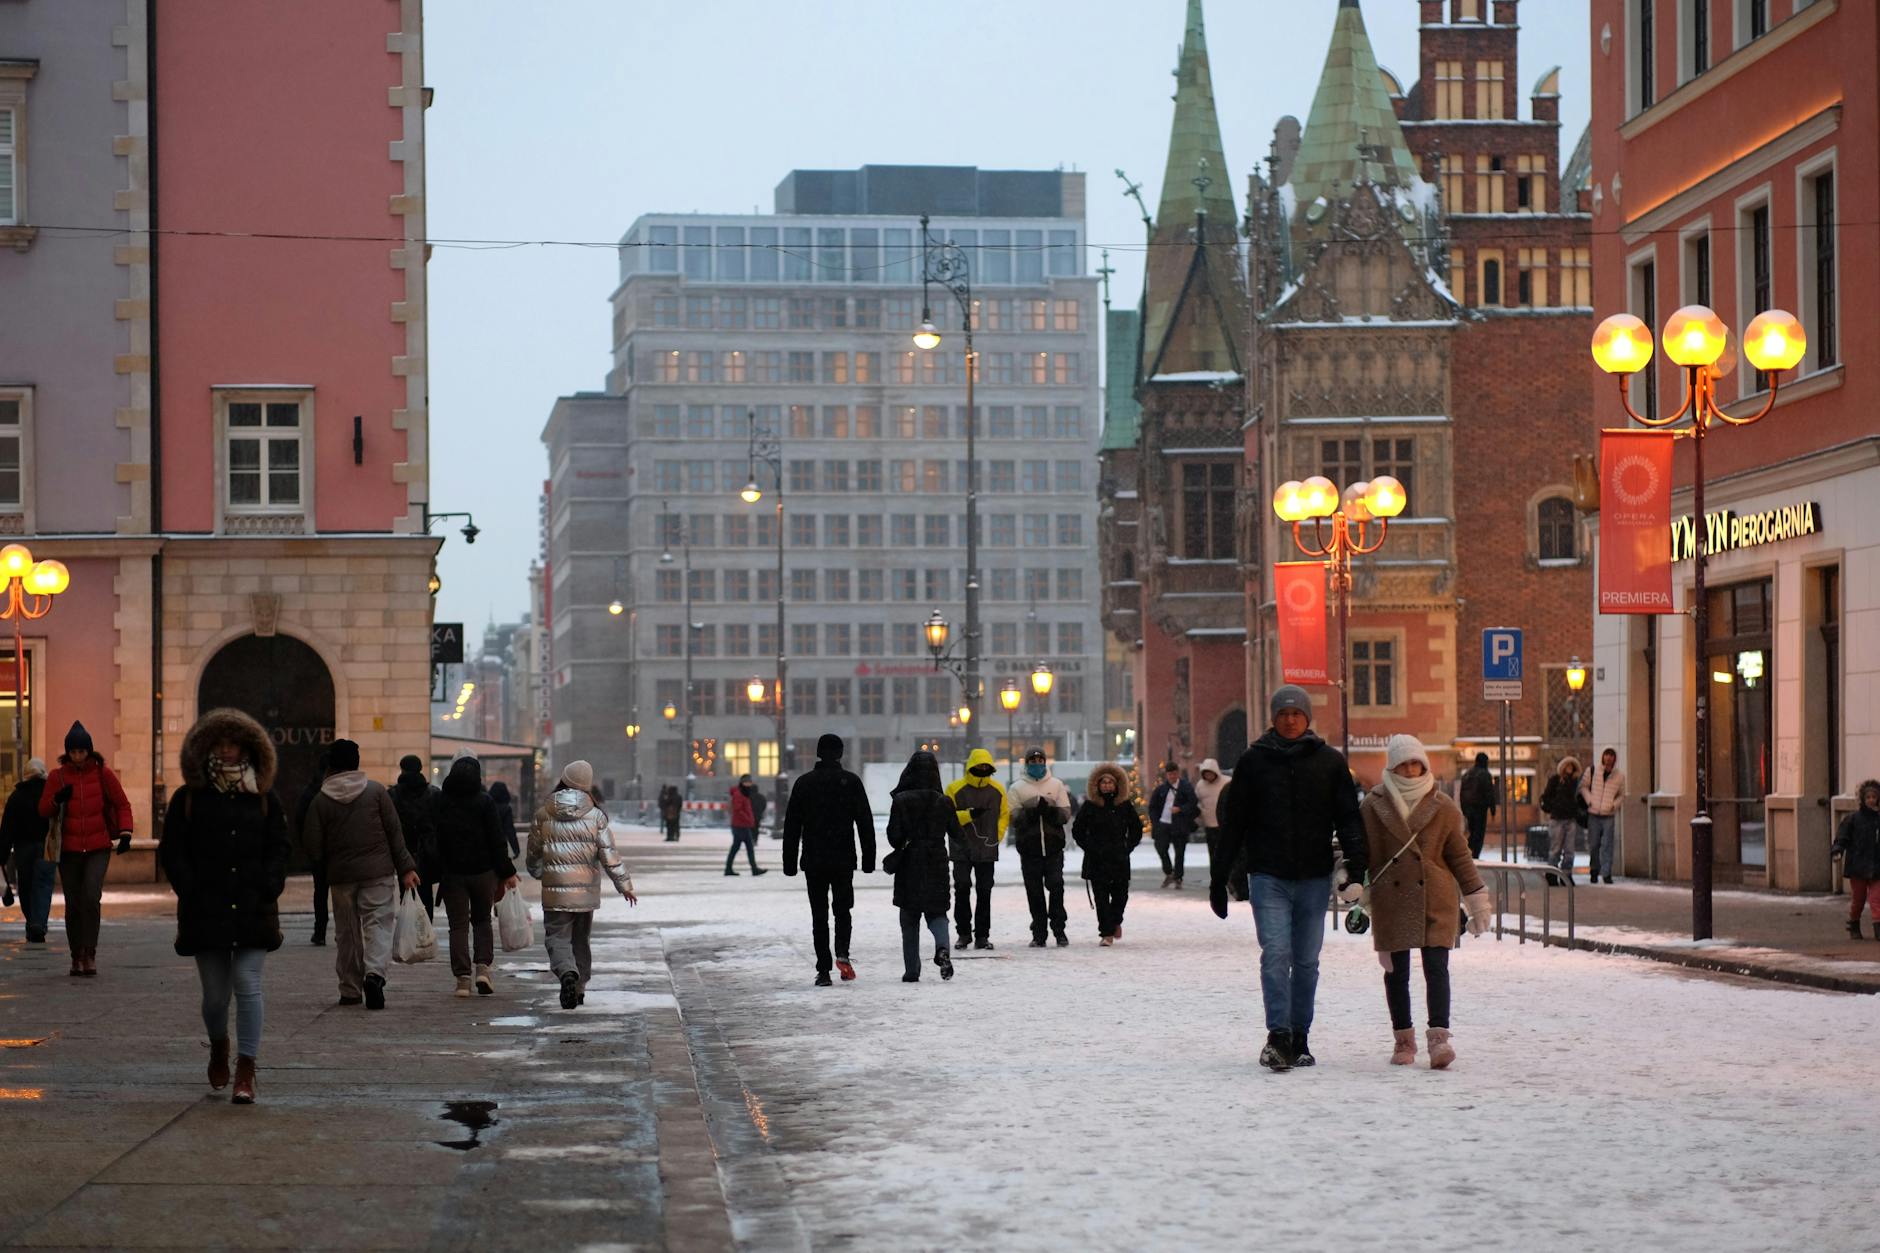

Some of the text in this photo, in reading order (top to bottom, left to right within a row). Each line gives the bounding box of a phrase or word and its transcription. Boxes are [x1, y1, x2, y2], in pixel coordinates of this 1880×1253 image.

[1731, 501, 1815, 549] PIEROGARNIA
[1602, 591, 1670, 604] PREMIERA
[1492, 634, 1515, 665] P
[1284, 669, 1327, 679] PREMIERA
